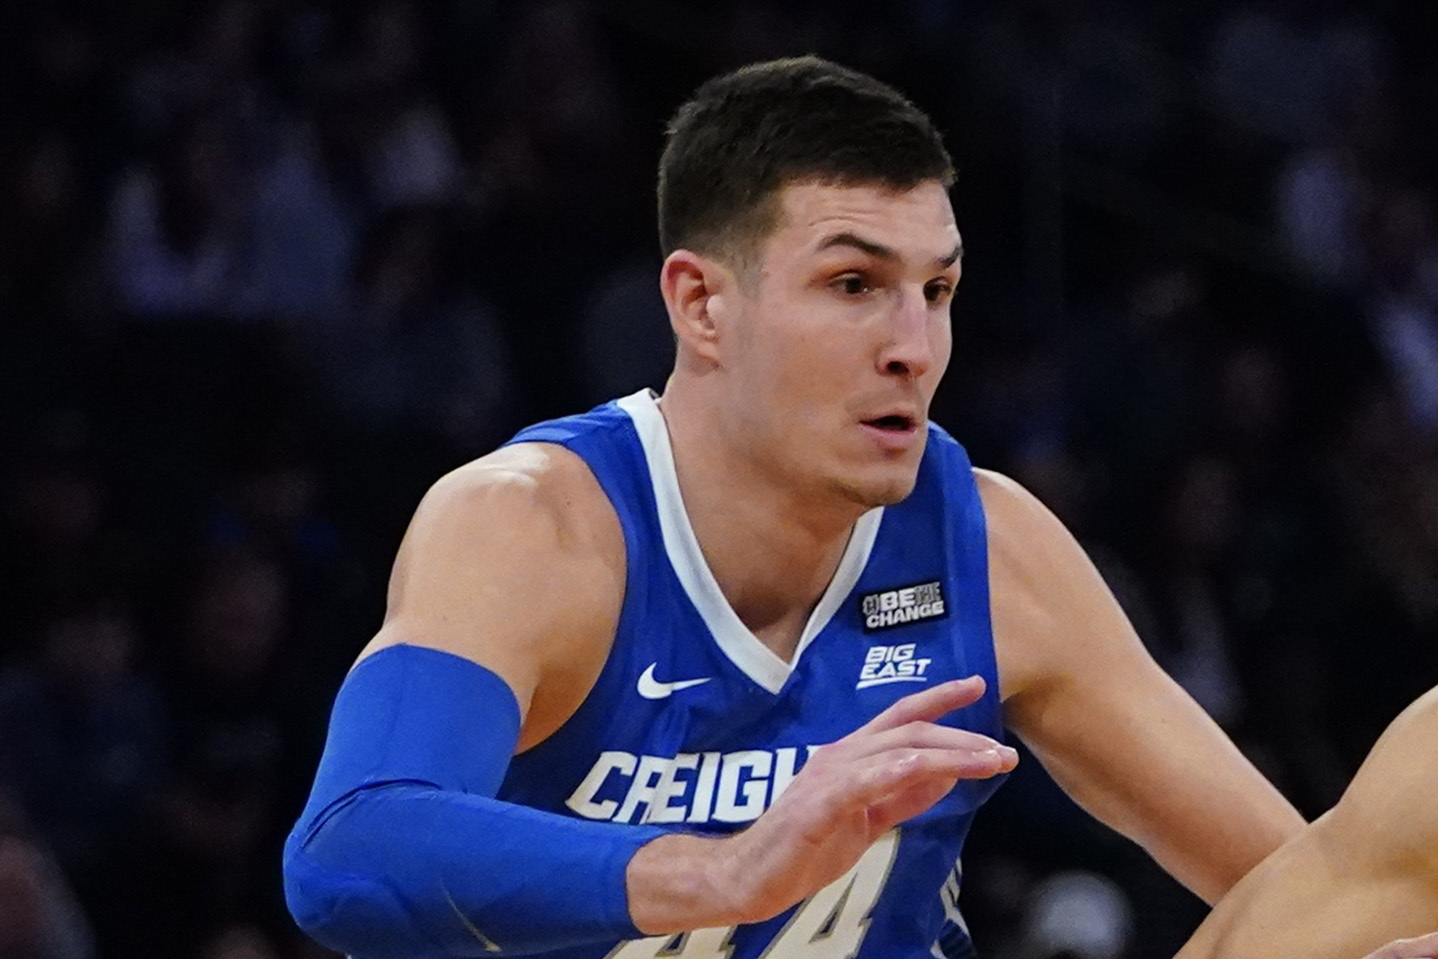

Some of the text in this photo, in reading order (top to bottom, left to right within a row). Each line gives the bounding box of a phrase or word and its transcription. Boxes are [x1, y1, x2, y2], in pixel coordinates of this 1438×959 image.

[866, 600, 945, 629] CHANGE
[865, 643, 917, 665] BIG
[860, 658, 932, 681] EAST
